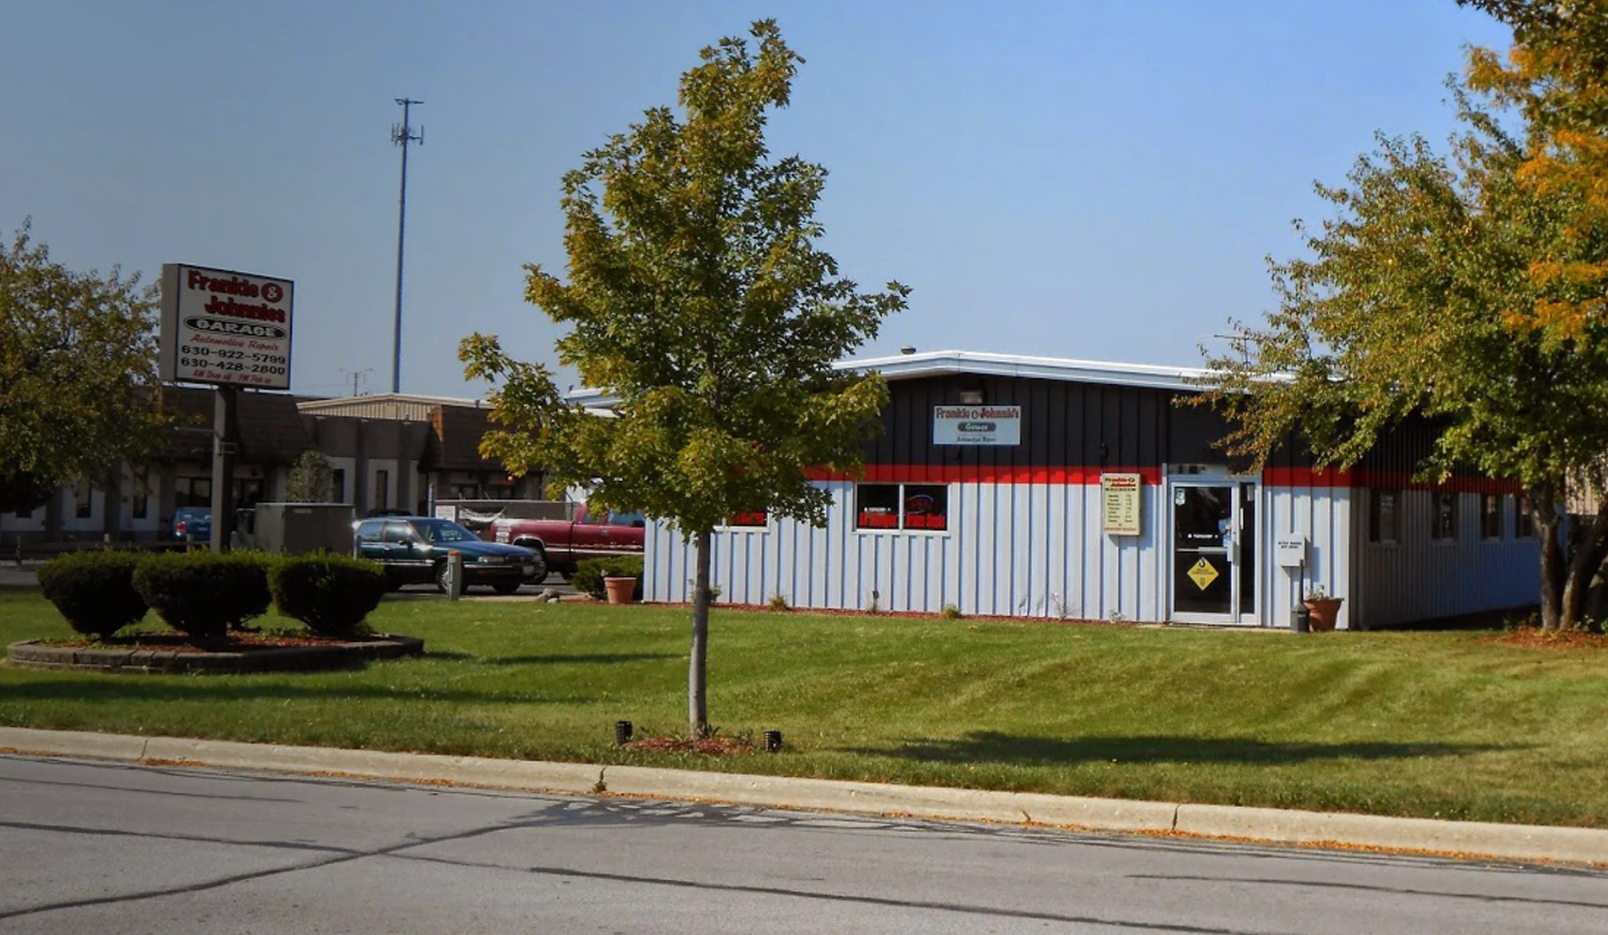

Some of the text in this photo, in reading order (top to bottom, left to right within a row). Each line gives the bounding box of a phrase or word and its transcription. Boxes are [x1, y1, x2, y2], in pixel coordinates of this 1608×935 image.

[188, 269, 259, 298] Frankie
[204, 295, 286, 323] Johnnies
[196, 319, 277, 338] GARAGE
[190, 333, 279, 352] Automotive Repair
[181, 345, 286, 365] 630-922-5799
[181, 357, 286, 376] 630-428-2800
